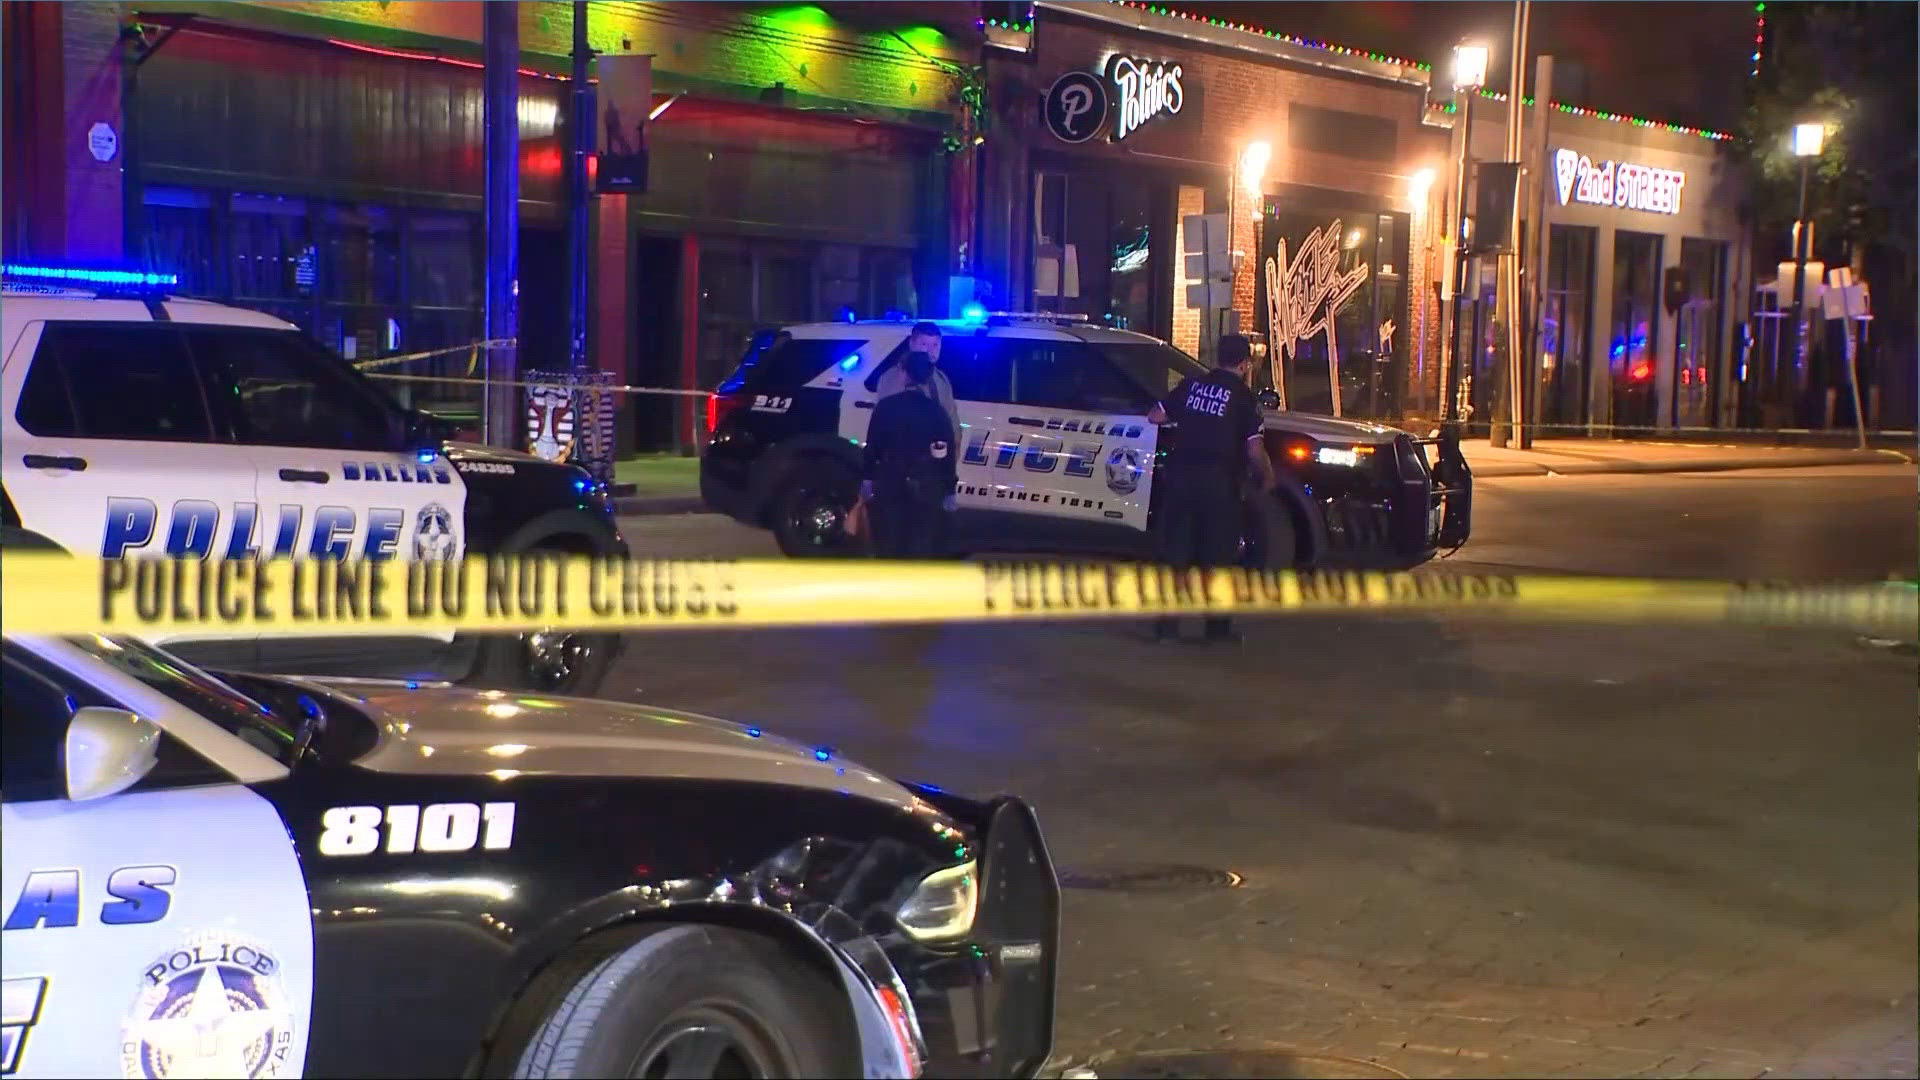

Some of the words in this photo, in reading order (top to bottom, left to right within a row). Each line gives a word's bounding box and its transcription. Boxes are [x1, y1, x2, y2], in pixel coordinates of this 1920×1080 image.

[1061, 84, 1093, 135] P
[1115, 57, 1183, 139] Politics
[1577, 155, 1615, 205] 2nd
[1616, 162, 1685, 214] STREET
[1186, 395, 1226, 416] POLICE
[1191, 382, 1231, 402] DALLAS
[1046, 417, 1144, 438] DALLAS
[342, 462, 451, 484] DALLAS
[962, 430, 1103, 478] LICE
[997, 490, 1051, 503] SINCE
[1060, 497, 1104, 510] 1881
[100, 496, 405, 561] POLICE
[101, 556, 275, 624] POLICE
[293, 556, 393, 622] LINE
[408, 556, 468, 620] DO
[487, 556, 570, 619] NOT
[320, 802, 515, 857] 8101
[145, 944, 274, 986] POLICE
